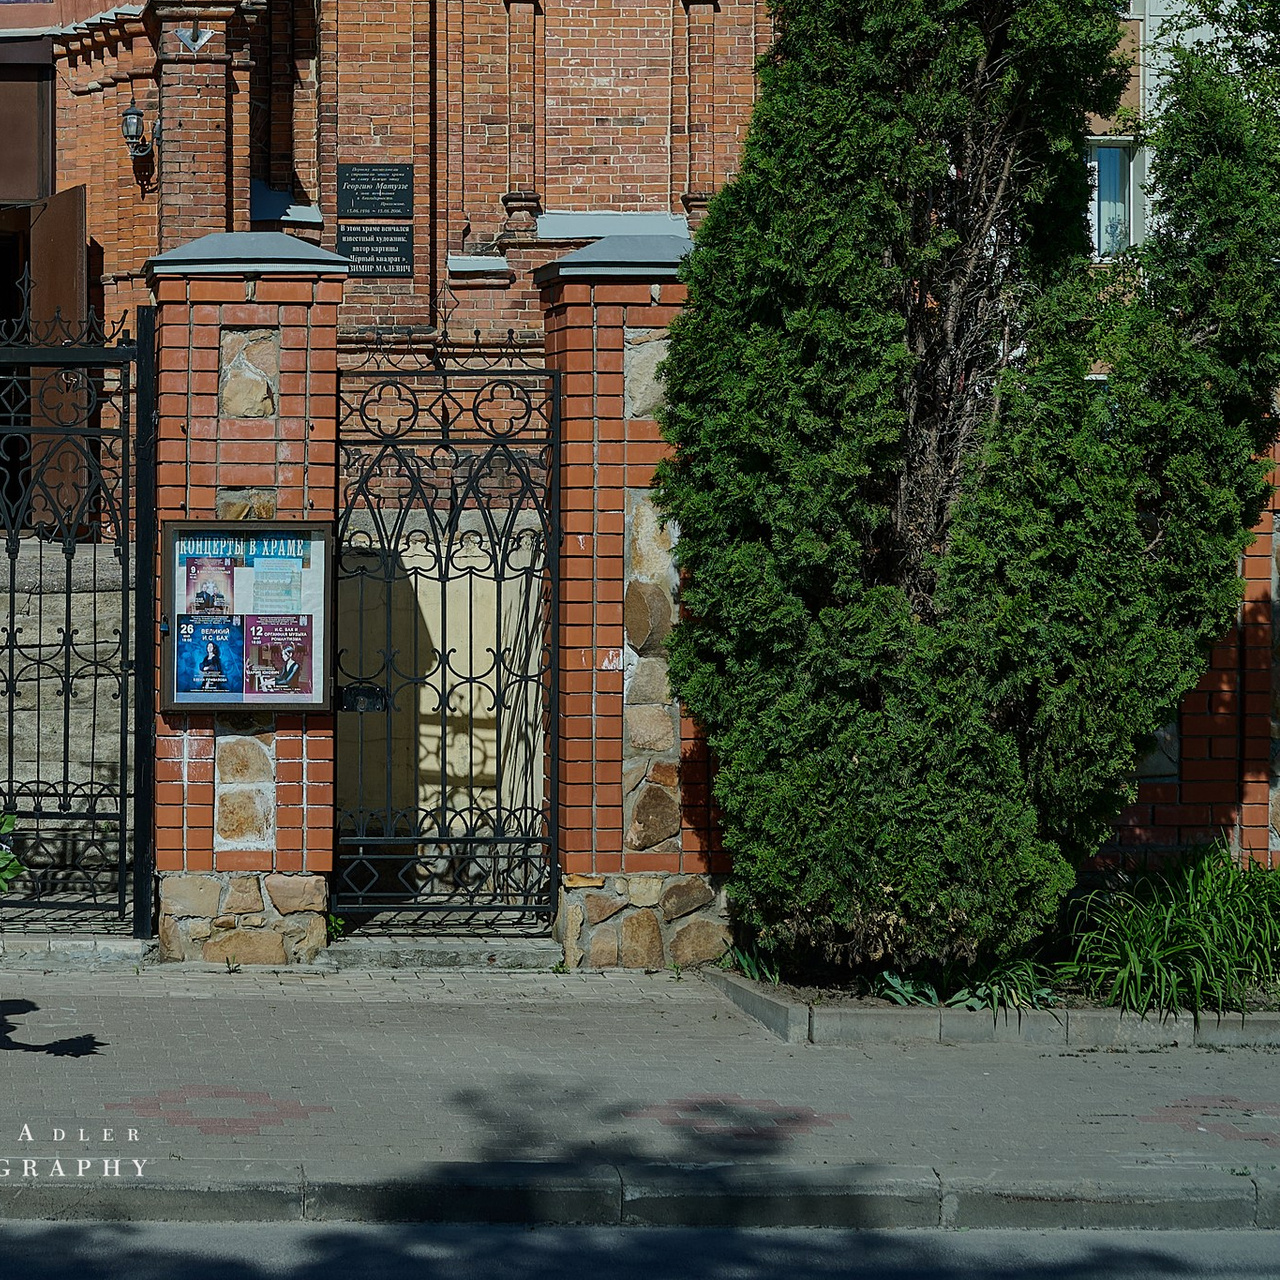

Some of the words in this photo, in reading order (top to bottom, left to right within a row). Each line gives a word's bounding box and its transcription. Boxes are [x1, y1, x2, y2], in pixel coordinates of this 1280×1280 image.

[180, 537, 244, 556] КОНЦЕРТЫ
[249, 539, 256, 555] В
[262, 539, 304, 556] ХРАМЕ
[180, 624, 194, 634] 26
[250, 626, 263, 636] 12
